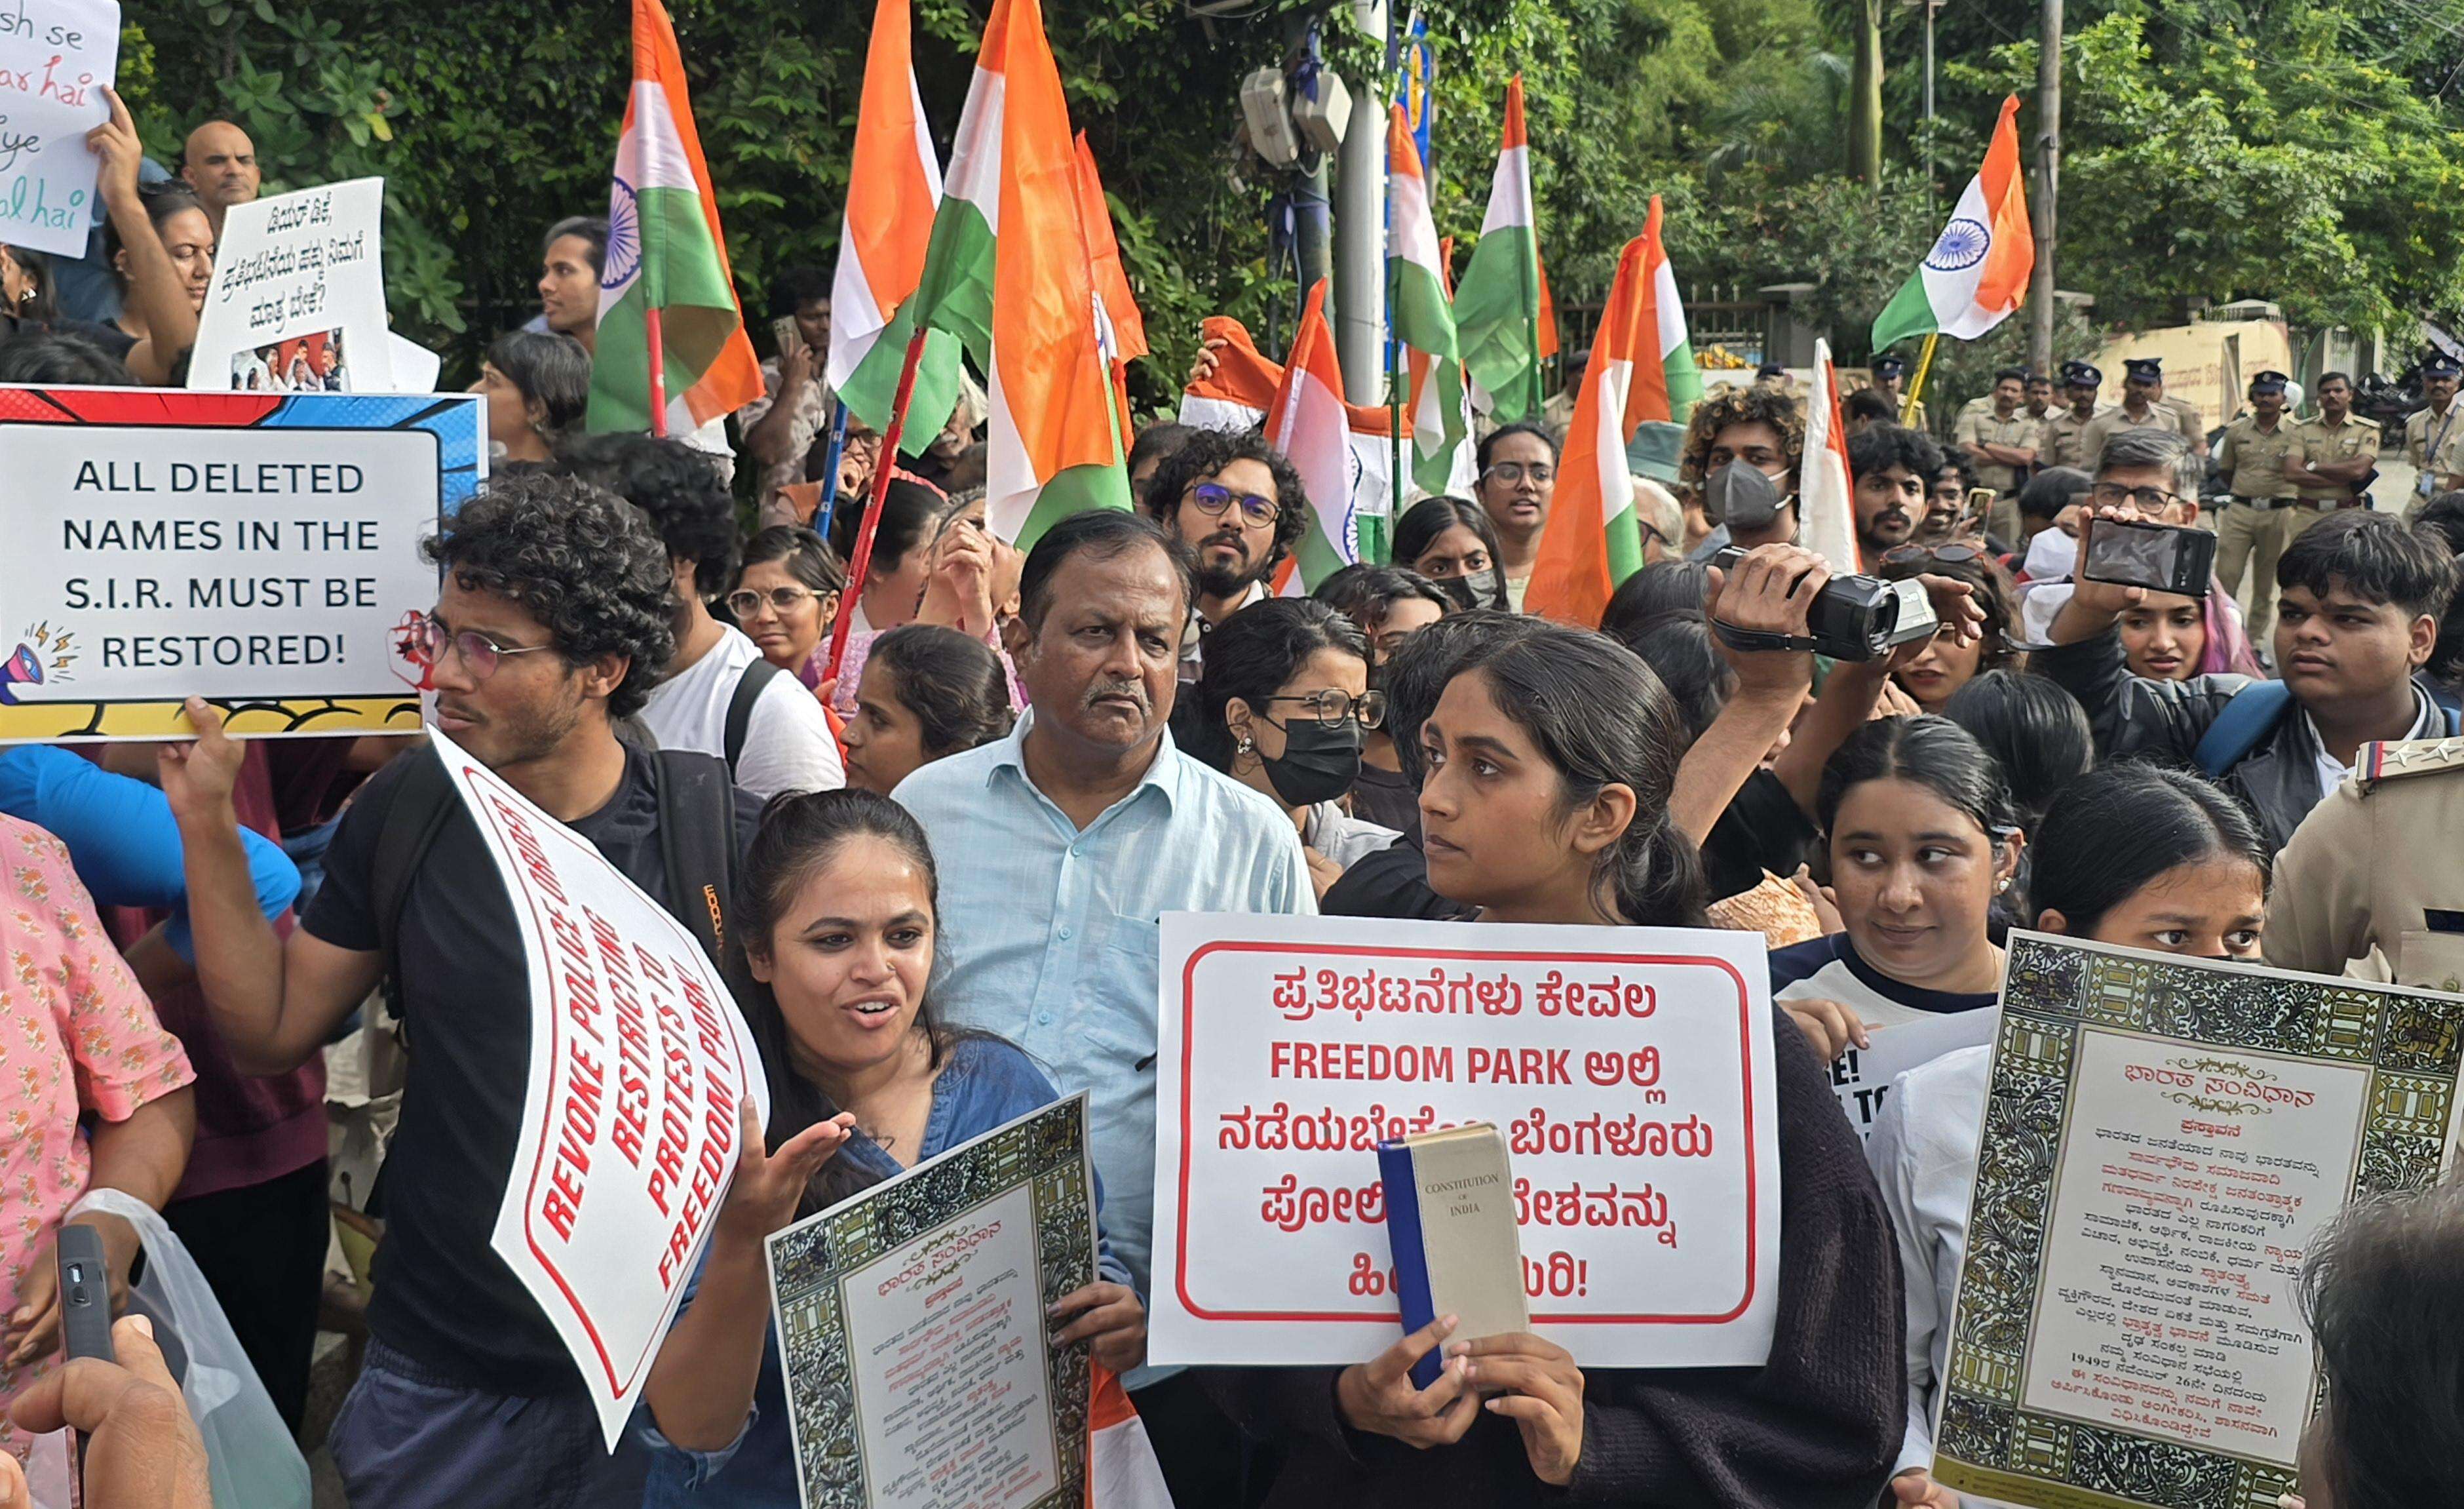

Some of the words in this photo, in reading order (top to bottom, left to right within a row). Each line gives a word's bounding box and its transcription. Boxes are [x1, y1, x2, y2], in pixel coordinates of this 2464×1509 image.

[46, 26, 83, 50] se
[40, 55, 93, 107] hai
[31, 178, 85, 230] hai
[328, 230, 364, 266] ನಿಮಗೆ
[73, 461, 156, 492] ALL
[171, 463, 364, 494] DELETED
[64, 520, 221, 551] NAMES
[238, 521, 280, 551] IN
[294, 521, 379, 551] THE
[66, 578, 173, 608] S.I.R.
[189, 578, 310, 608] MUST
[326, 578, 377, 607] BE
[103, 634, 345, 667] RESTORED!
[489, 794, 569, 906] ORDER
[539, 895, 604, 1046] POLICE
[632, 941, 676, 998] TO
[1272, 965, 1522, 1022] ಪ್ರತಿಭಟನೆಗಳು
[1535, 970, 1657, 1019] ಕೇವಲ
[581, 904, 651, 1170] RESTRICTING
[1271, 1042, 1453, 1083] FREEDOM
[1468, 1047, 1572, 1085] PARK
[1585, 1046, 1666, 1105] ಅಲ್ಲಿ
[1824, 1049, 1860, 1086] E!
[2125, 1065, 2195, 1088] ಭಾರತ
[2205, 1077, 2315, 1107] ಸಂವಿಧಾನ
[647, 992, 694, 1220] PROTESTS
[1218, 1103, 1477, 1152] ನಡೆಯಬೇಕೆ
[1510, 1107, 1713, 1158] ಬೆಂಗಳೂರು
[2180, 1118, 2242, 1138] ಪ್ರಸ್ತಾವನೆ
[543, 1036, 604, 1244] REVOKE
[2095, 1127, 2141, 1144] ಭಾರತದ
[2220, 1150, 2248, 1164] ನಾವು
[2256, 1154, 2320, 1179] ಭಾರತವನ್ನು
[658, 1065, 735, 1293] FREEDOM
[1425, 1173, 1499, 1194] CONSTITUTION
[1450, 1202, 1480, 1217] INDIA
